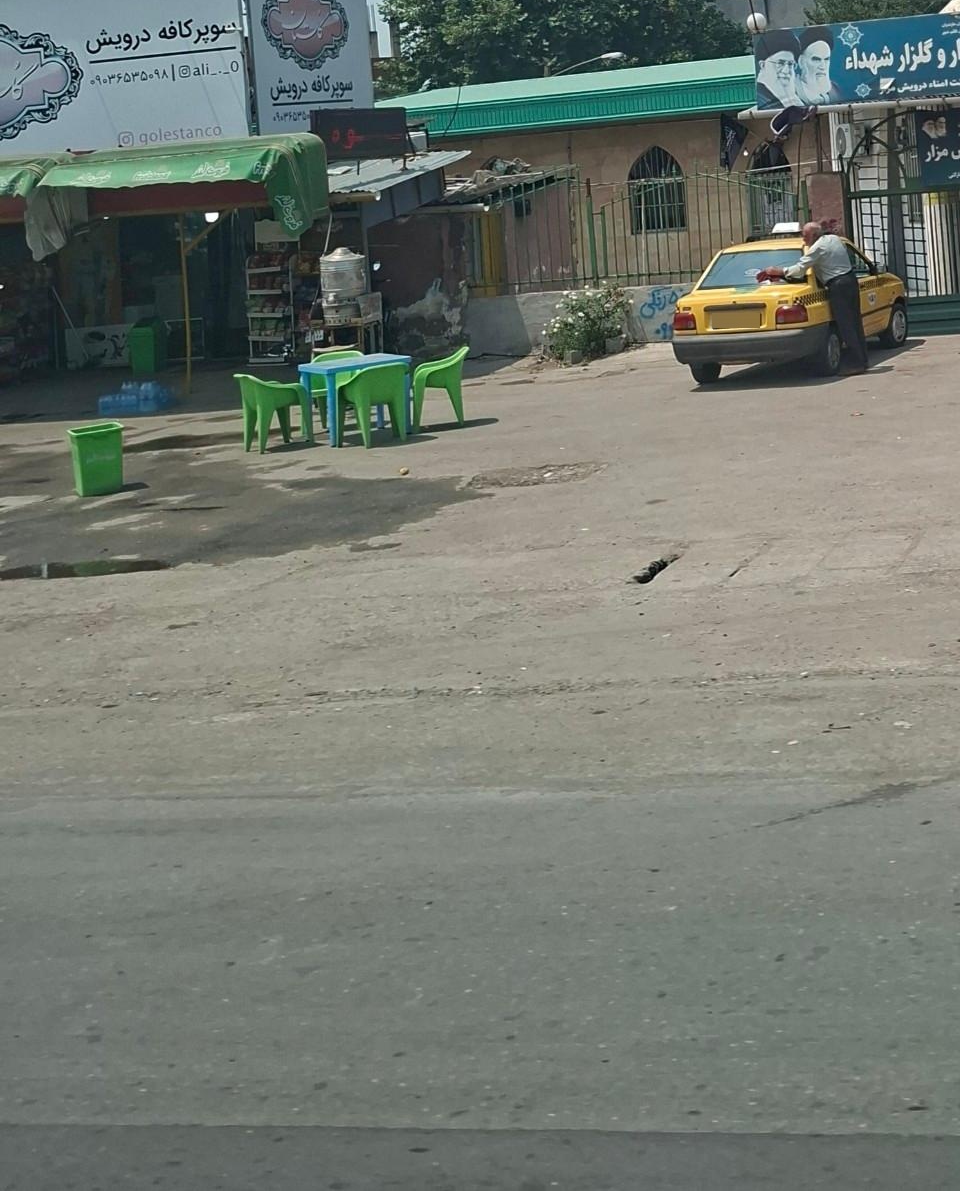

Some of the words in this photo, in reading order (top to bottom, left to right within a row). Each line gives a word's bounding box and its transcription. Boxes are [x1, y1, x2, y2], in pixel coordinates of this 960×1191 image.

[86, 29, 150, 54] درویش
[845, 45, 894, 75] شهداء
[898, 38, 933, 72] گلزار
[937, 48, 946, 68] و
[270, 77, 308, 101] درویش
[897, 81, 927, 93] درویش
[929, 79, 948, 89] امناء
[925, 144, 949, 162] مزار
